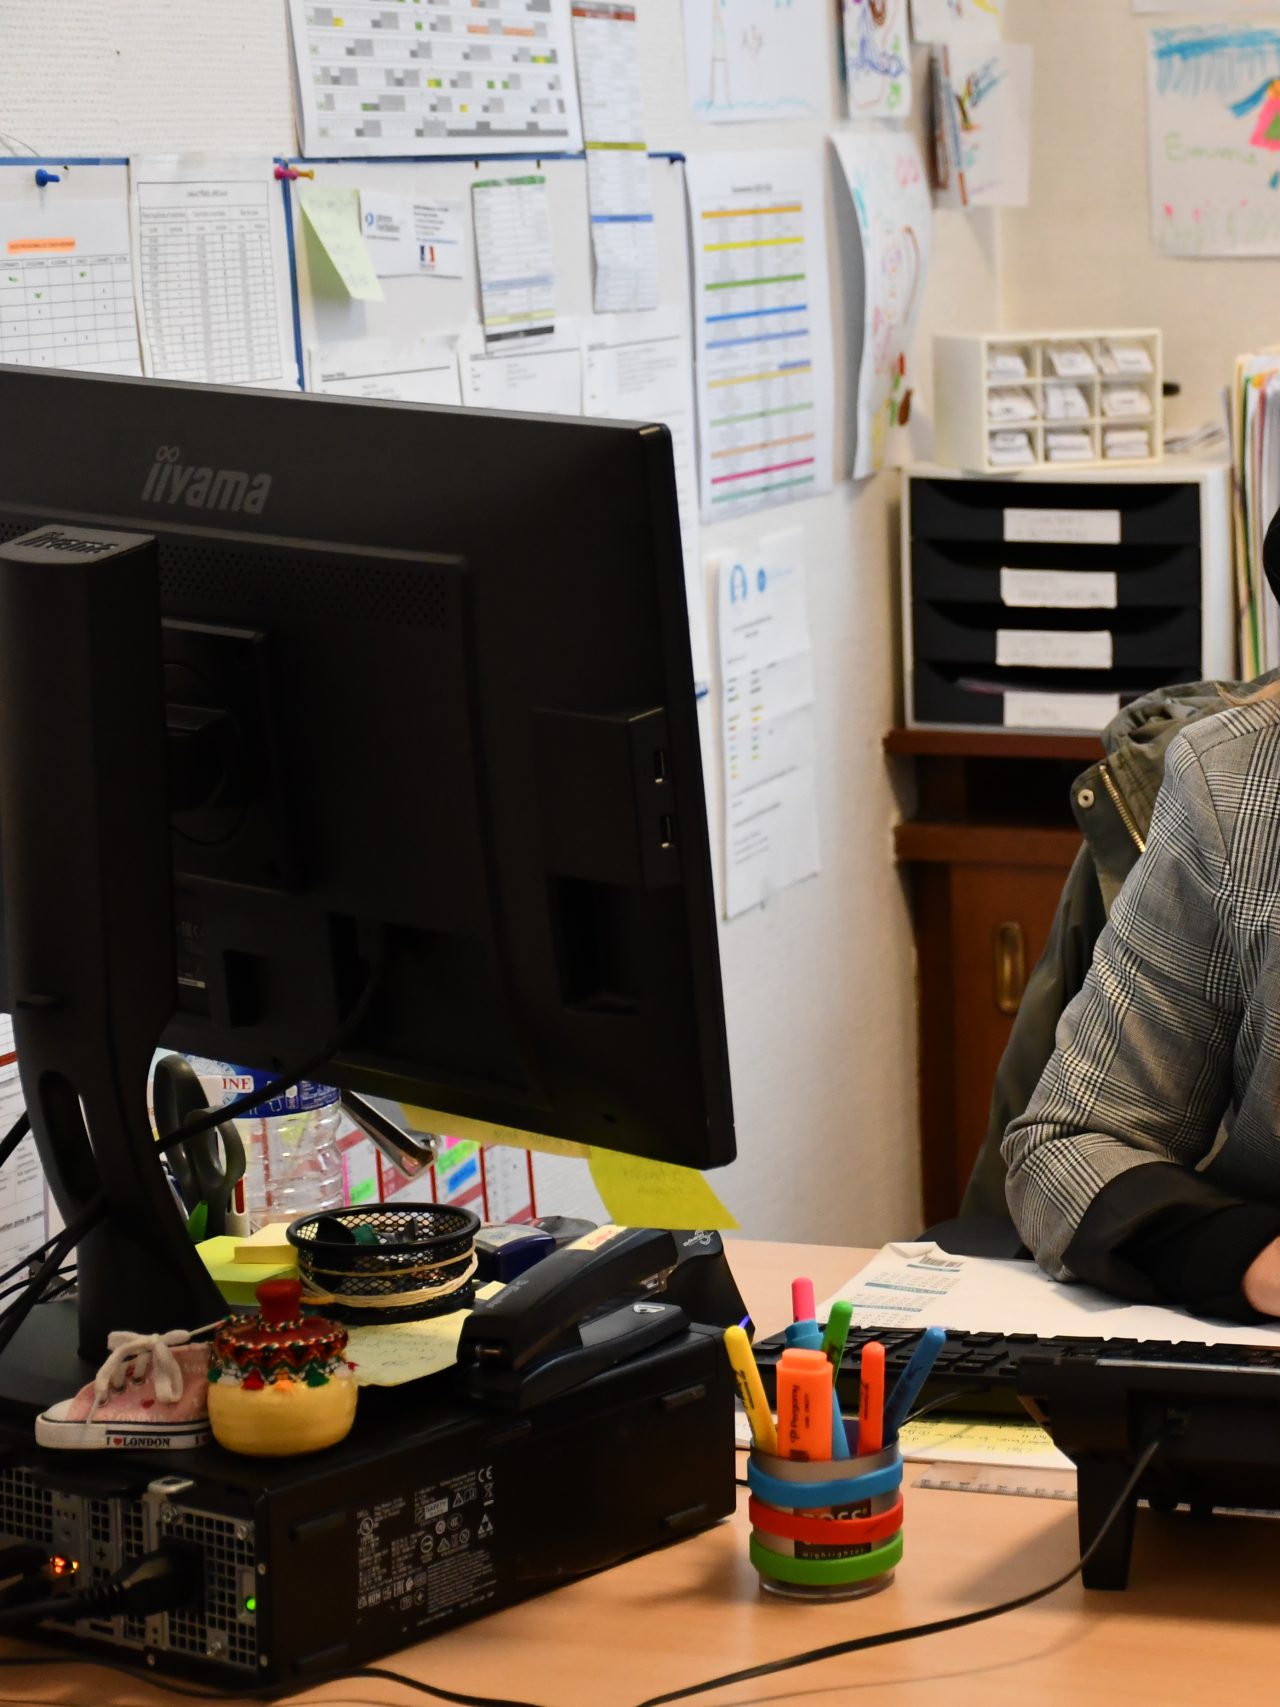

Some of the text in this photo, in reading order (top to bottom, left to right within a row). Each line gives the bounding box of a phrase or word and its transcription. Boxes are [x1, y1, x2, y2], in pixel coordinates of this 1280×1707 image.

[141, 446, 272, 514] iiyama
[222, 1078, 250, 1090] INE
[106, 1437, 171, 1447] I LONDON
